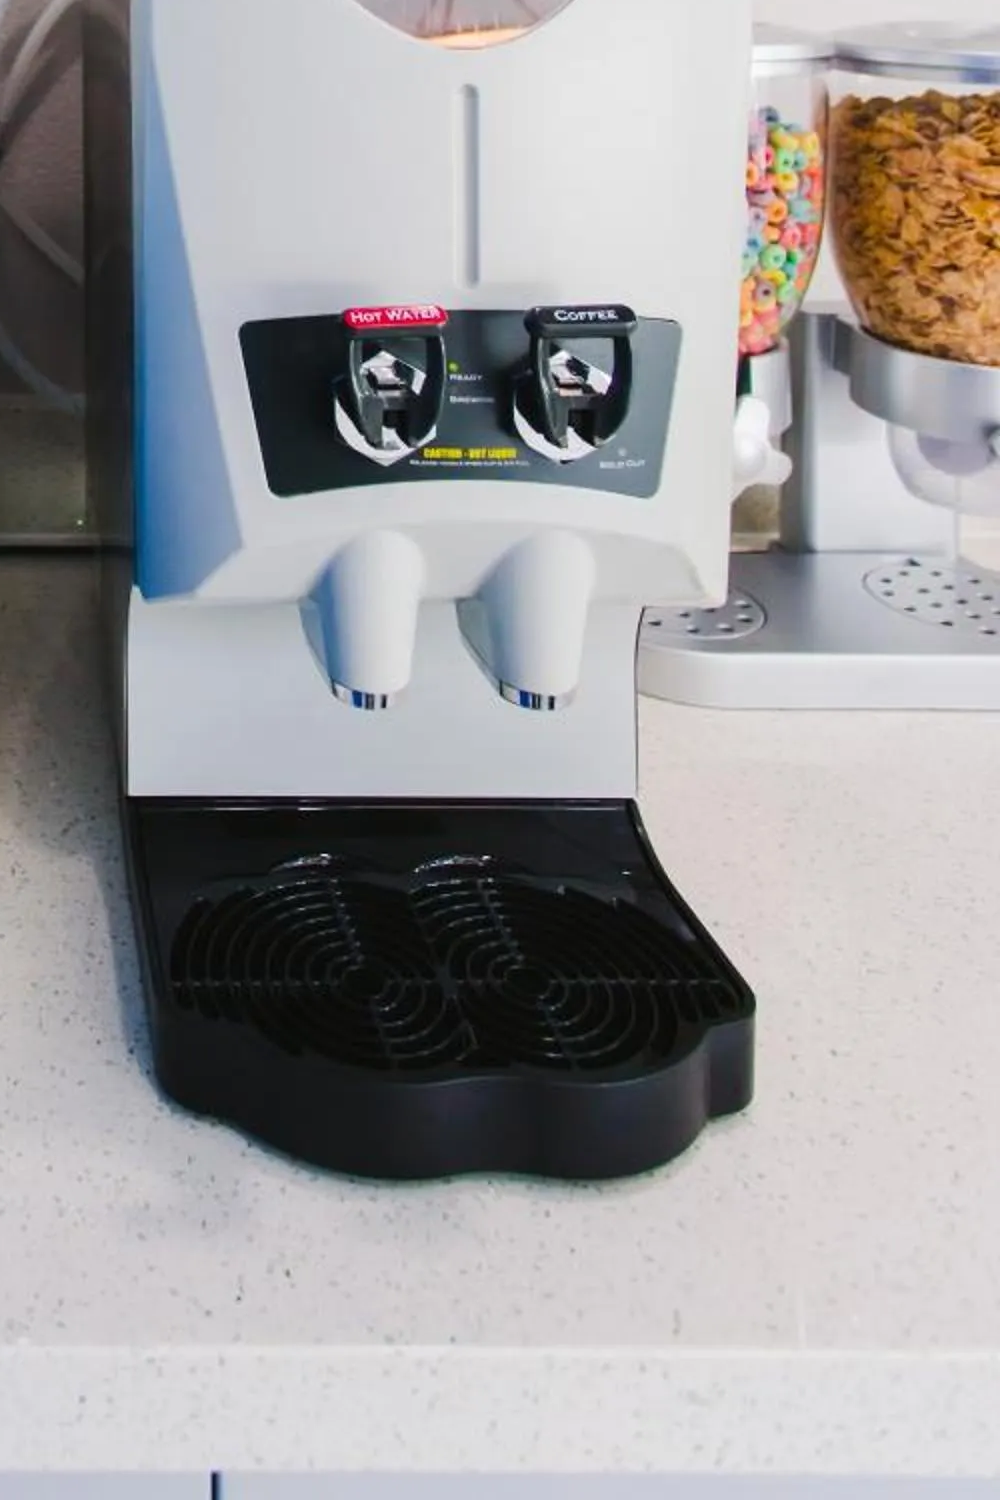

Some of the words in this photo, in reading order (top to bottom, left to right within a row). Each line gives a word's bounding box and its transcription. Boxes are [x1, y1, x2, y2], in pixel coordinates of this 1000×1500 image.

[350, 311, 382, 323] HOT
[383, 304, 440, 321] WATER
[553, 308, 618, 321] COFFEE
